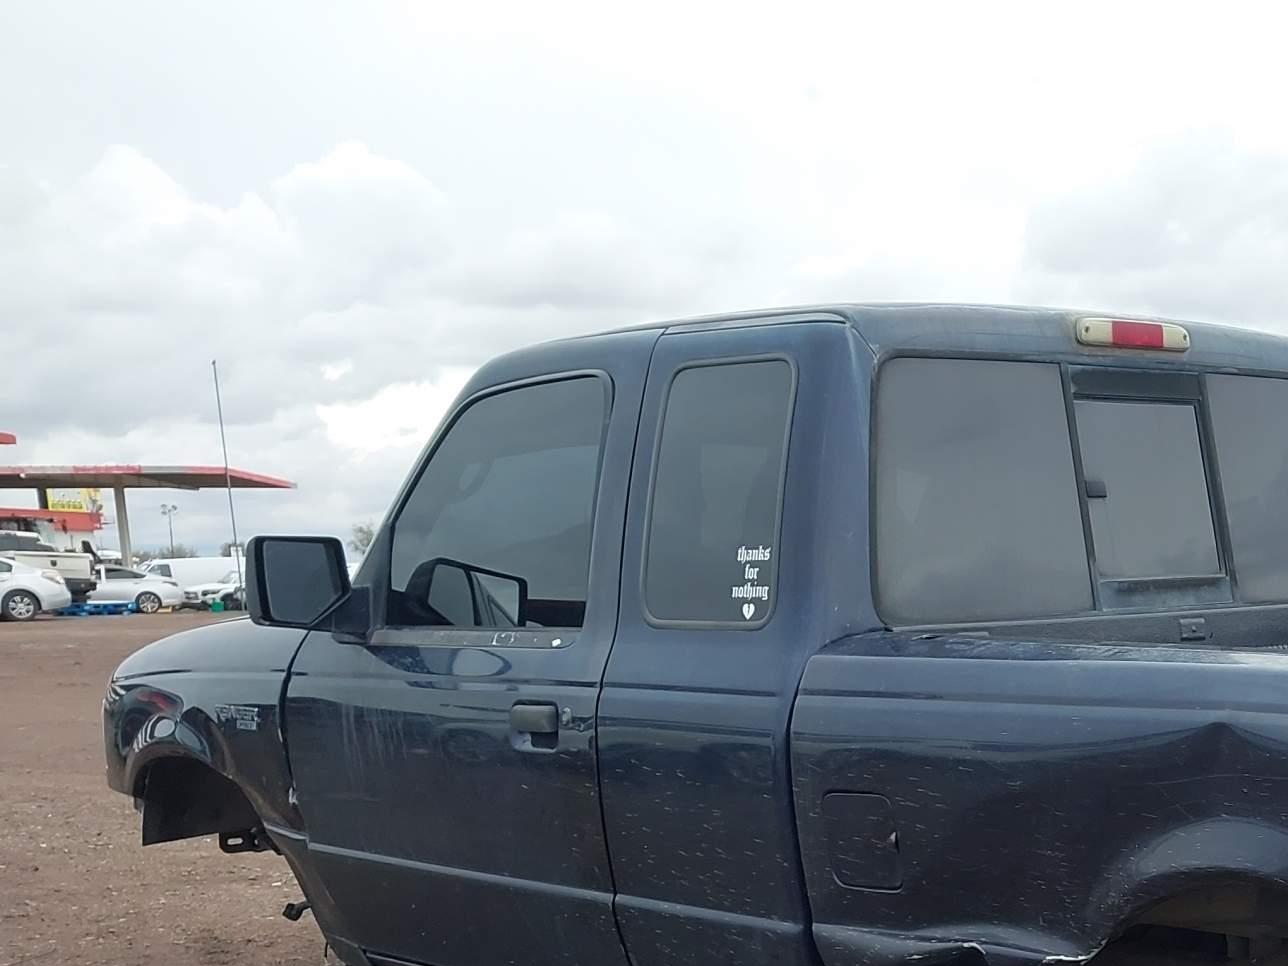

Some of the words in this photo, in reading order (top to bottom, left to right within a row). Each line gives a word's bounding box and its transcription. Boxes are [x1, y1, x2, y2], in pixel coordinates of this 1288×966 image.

[737, 545, 771, 564] thanks
[744, 563, 760, 580] for
[731, 581, 770, 601] nothing
